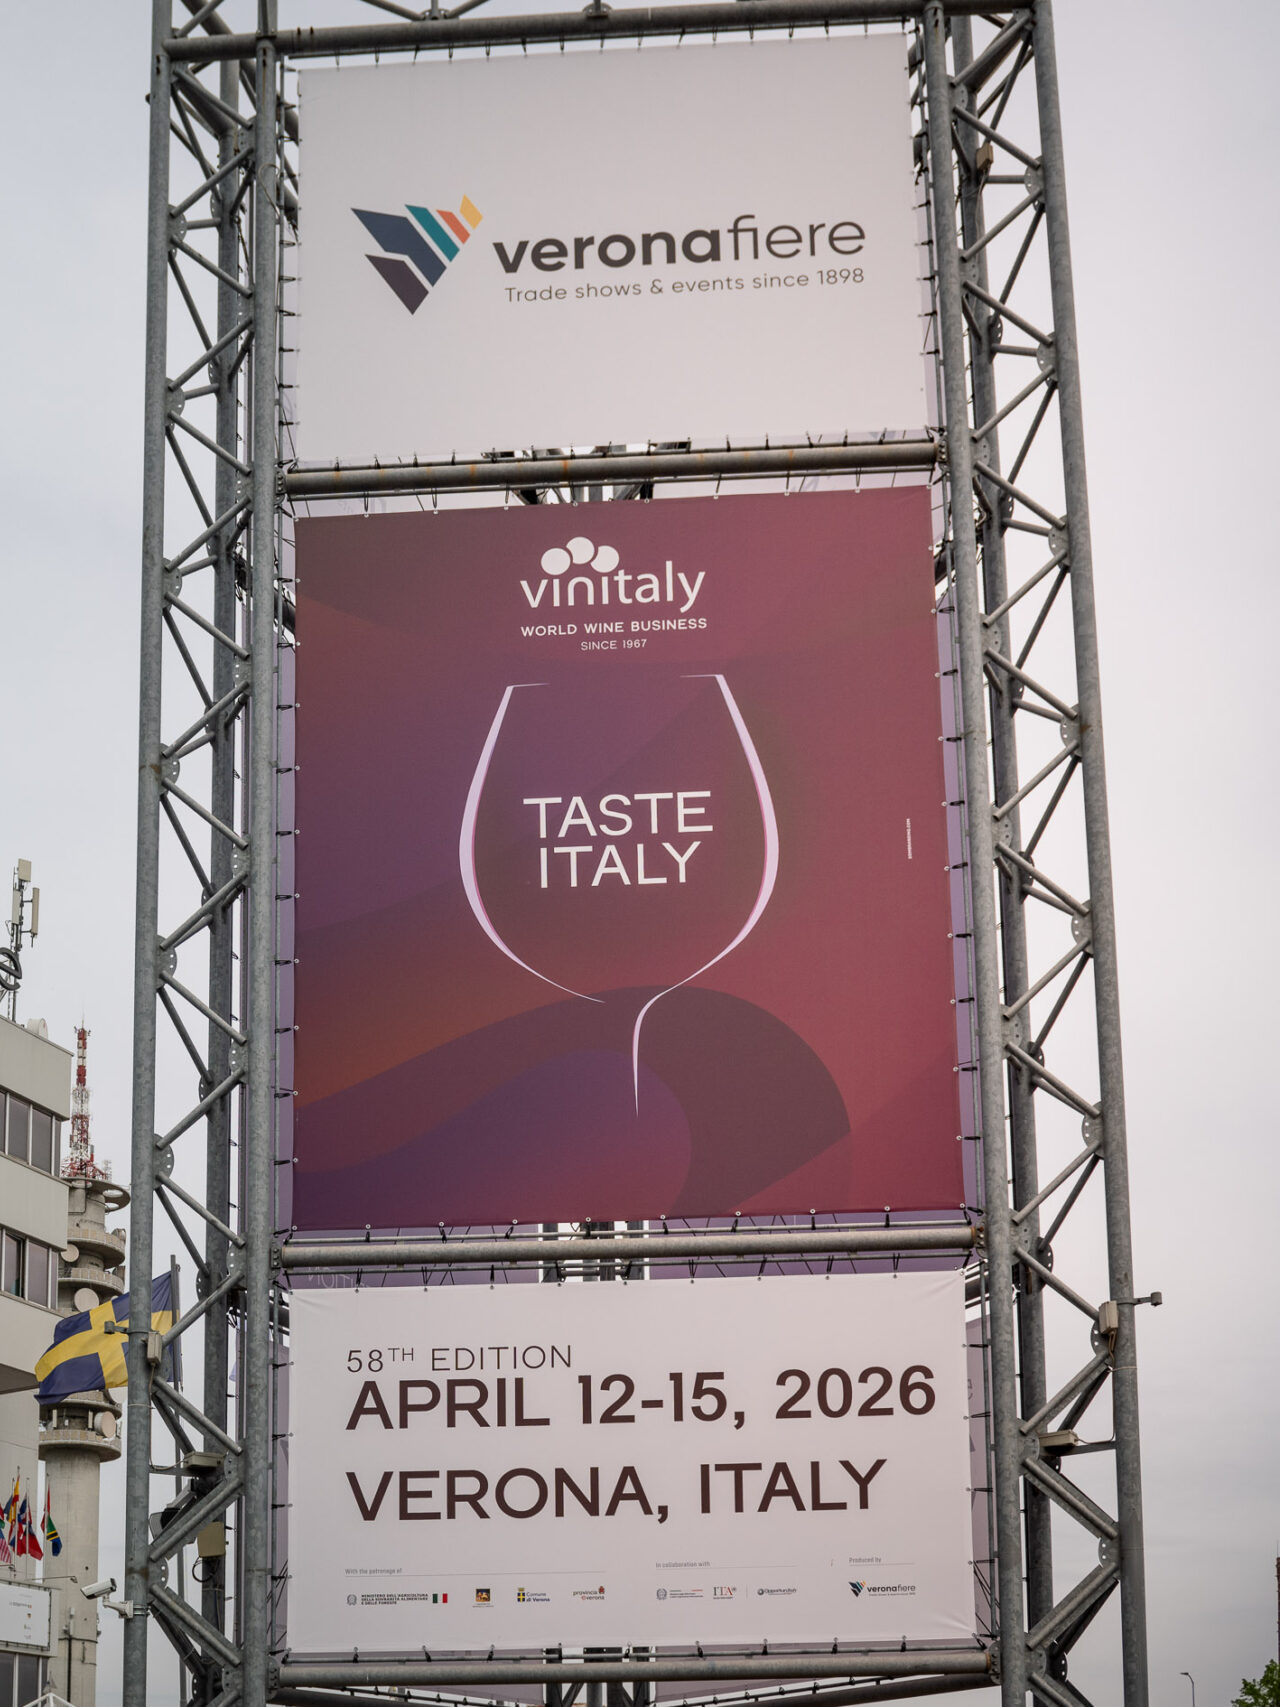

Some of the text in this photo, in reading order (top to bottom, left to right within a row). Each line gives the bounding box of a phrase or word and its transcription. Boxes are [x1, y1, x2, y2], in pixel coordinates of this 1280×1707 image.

[492, 214, 866, 274] veronafiere
[504, 268, 864, 302] Trade shows & events since 1898
[520, 560, 706, 613] vinitaly
[520, 618, 708, 637] WORLD WINE BUSINESS
[580, 639, 647, 651] SINCE 1967
[523, 790, 714, 838] TASTE
[540, 841, 701, 889] ITALY
[346, 1344, 572, 1374] 58TH EDITION
[345, 1364, 936, 1431] APRIL 12-15, 2026
[345, 1458, 888, 1525] VERONA, ITALY
